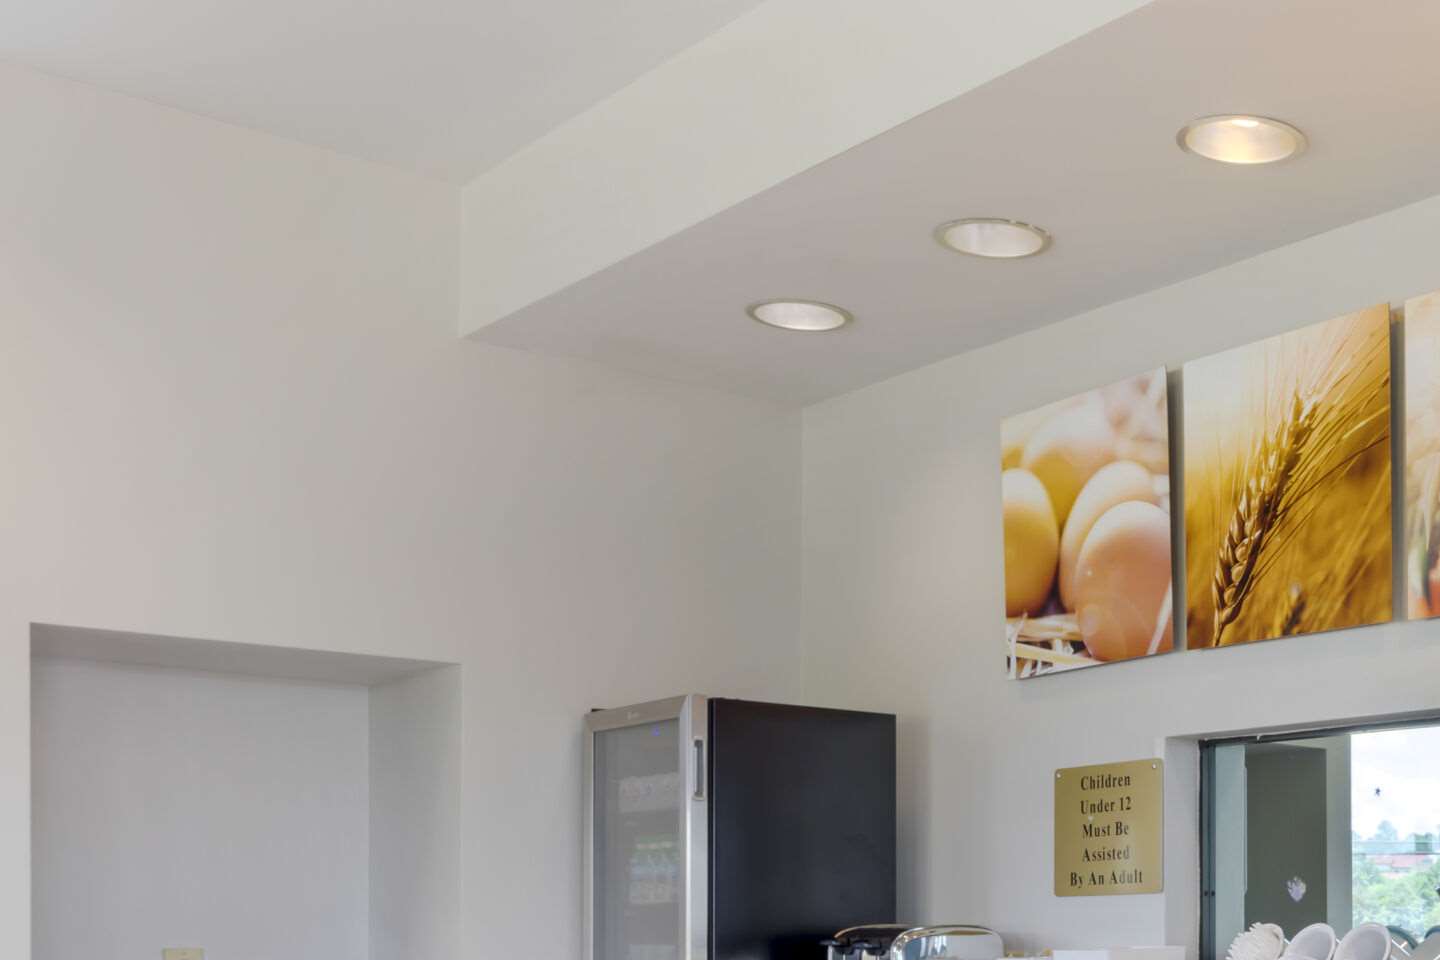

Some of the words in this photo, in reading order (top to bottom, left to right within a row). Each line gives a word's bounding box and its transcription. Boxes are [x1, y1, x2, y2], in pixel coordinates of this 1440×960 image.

[1080, 774, 1131, 791] Children
[1080, 799, 1115, 815] Under
[1120, 796, 1132, 811] 12
[1082, 823, 1111, 839] Must
[1115, 821, 1129, 836] Be
[1082, 845, 1130, 862] Assisted
[1070, 872, 1083, 888] By
[1088, 871, 1105, 886] An
[1110, 869, 1143, 885] Adult
